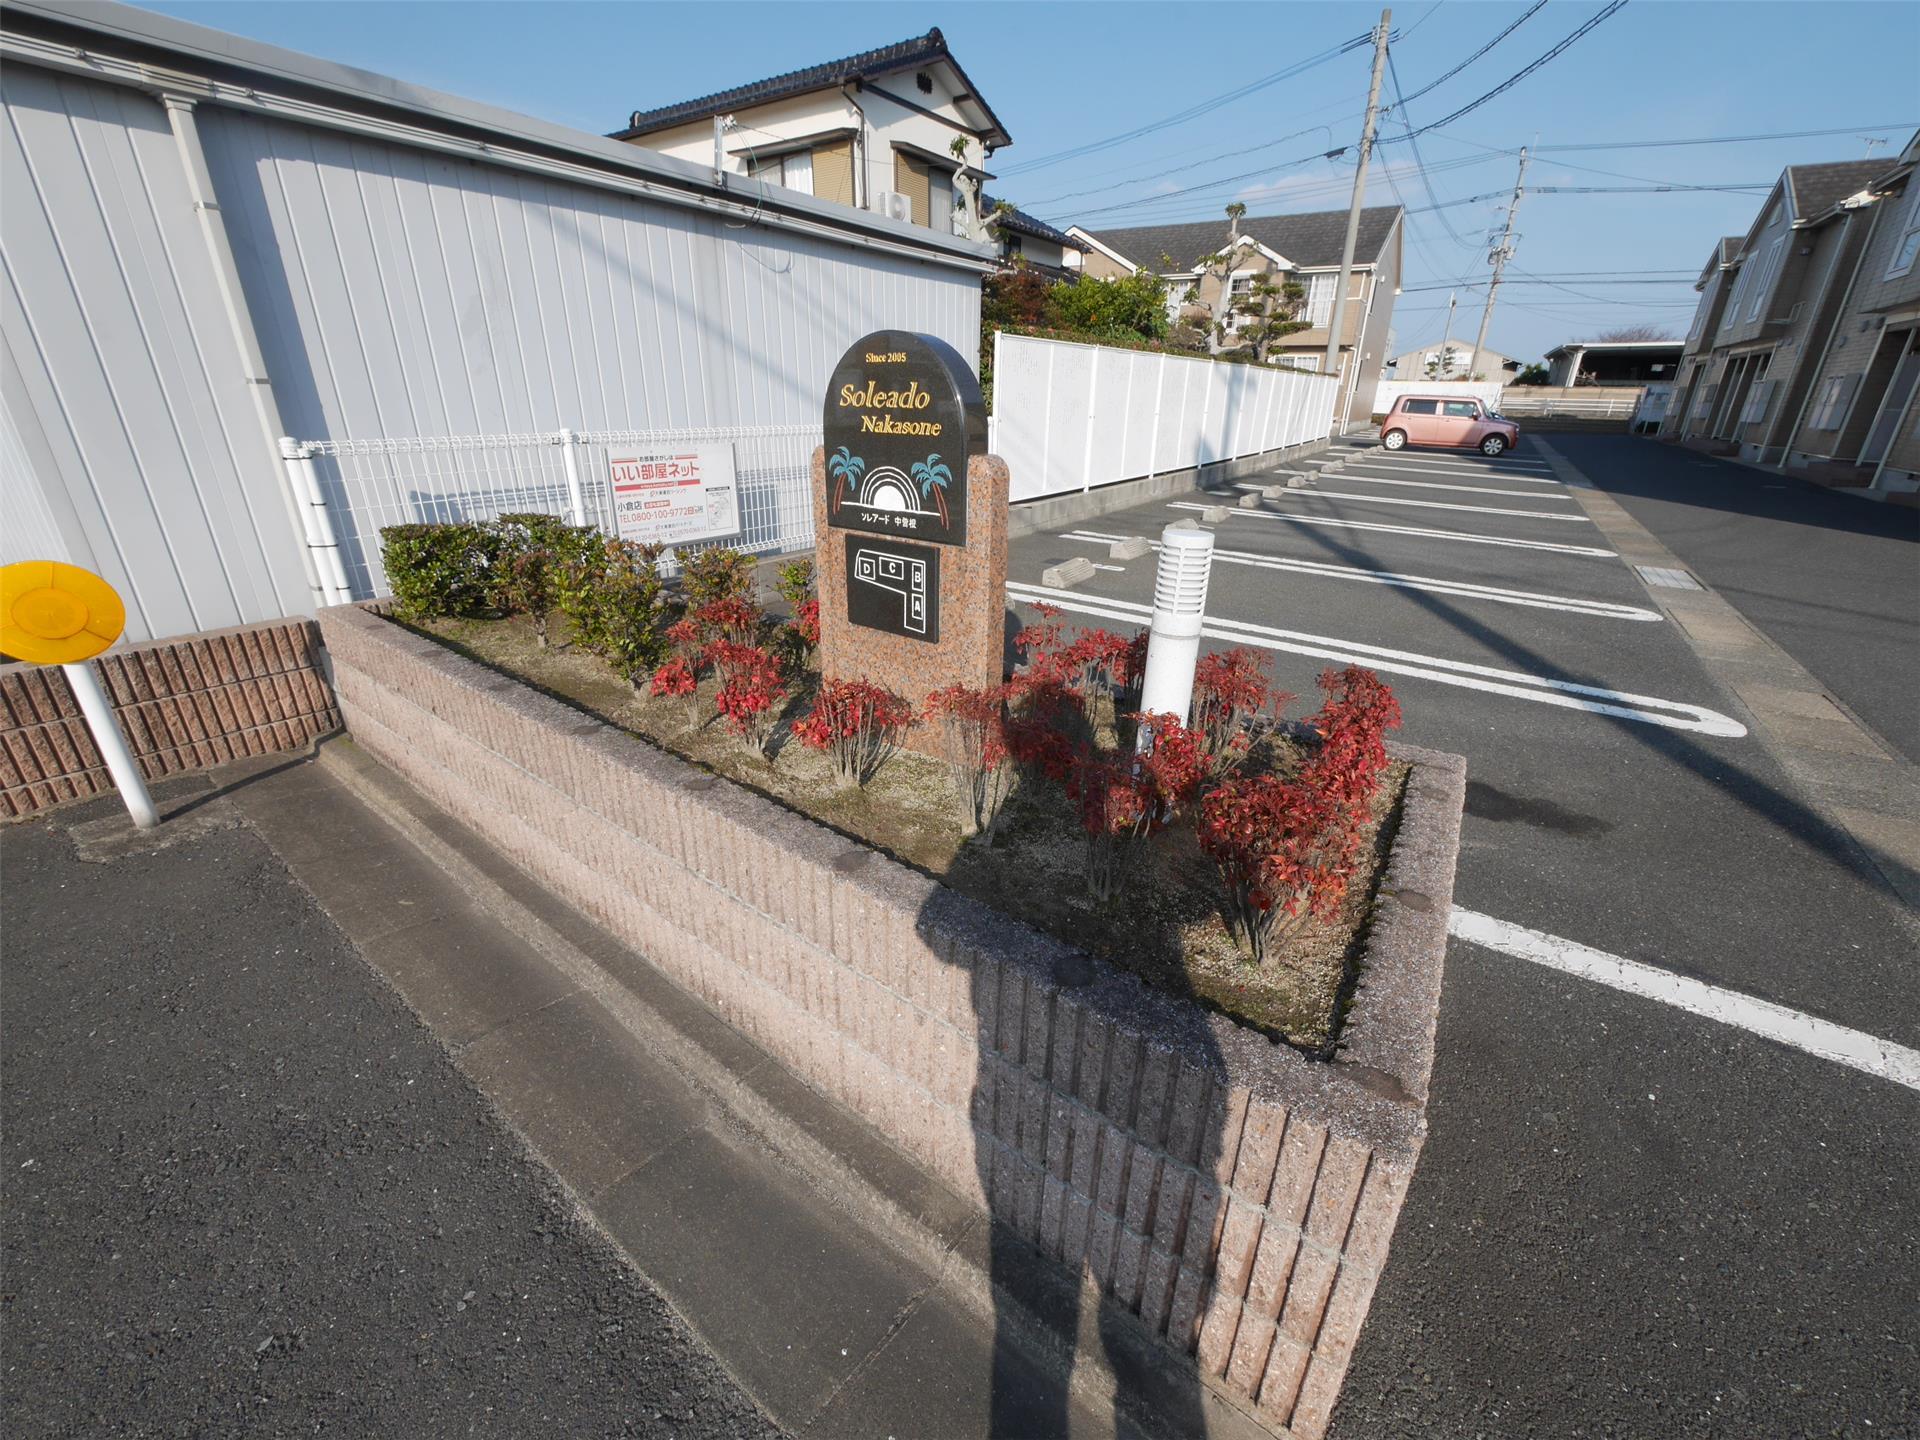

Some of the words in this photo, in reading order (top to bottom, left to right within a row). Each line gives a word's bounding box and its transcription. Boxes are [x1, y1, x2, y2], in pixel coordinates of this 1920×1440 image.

[865, 352, 886, 363] Since
[887, 352, 907, 362] 2005
[839, 380, 930, 409] Soleado
[860, 414, 942, 436] Nakasone
[611, 461, 700, 482] いい部屋ネット
[617, 500, 642, 512] 小倉店
[861, 512, 890, 525] ソレアード
[863, 563, 871, 574] D
[889, 562, 896, 574] C
[914, 572, 921, 583] B
[914, 600, 921, 612] A
